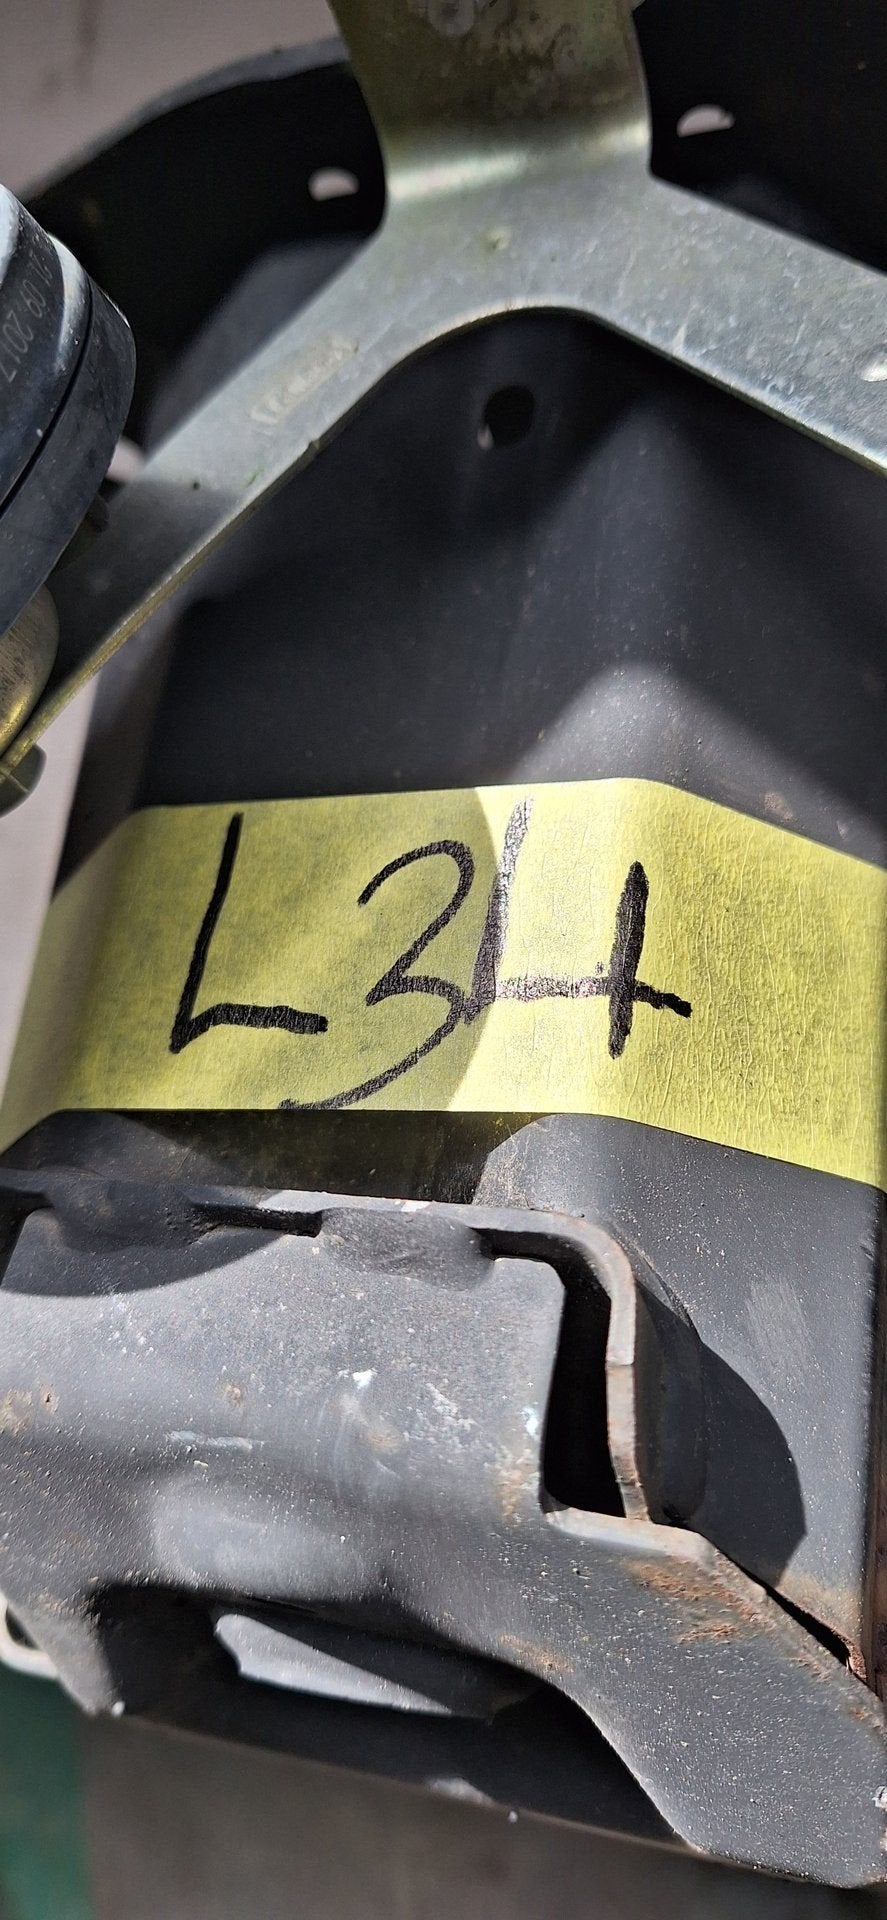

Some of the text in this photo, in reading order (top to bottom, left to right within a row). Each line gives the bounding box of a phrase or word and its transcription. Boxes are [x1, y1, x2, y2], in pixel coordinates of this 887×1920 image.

[19, 279, 46, 318] 09
[0, 311, 34, 383] 2017
[169, 795, 692, 1110] L34
